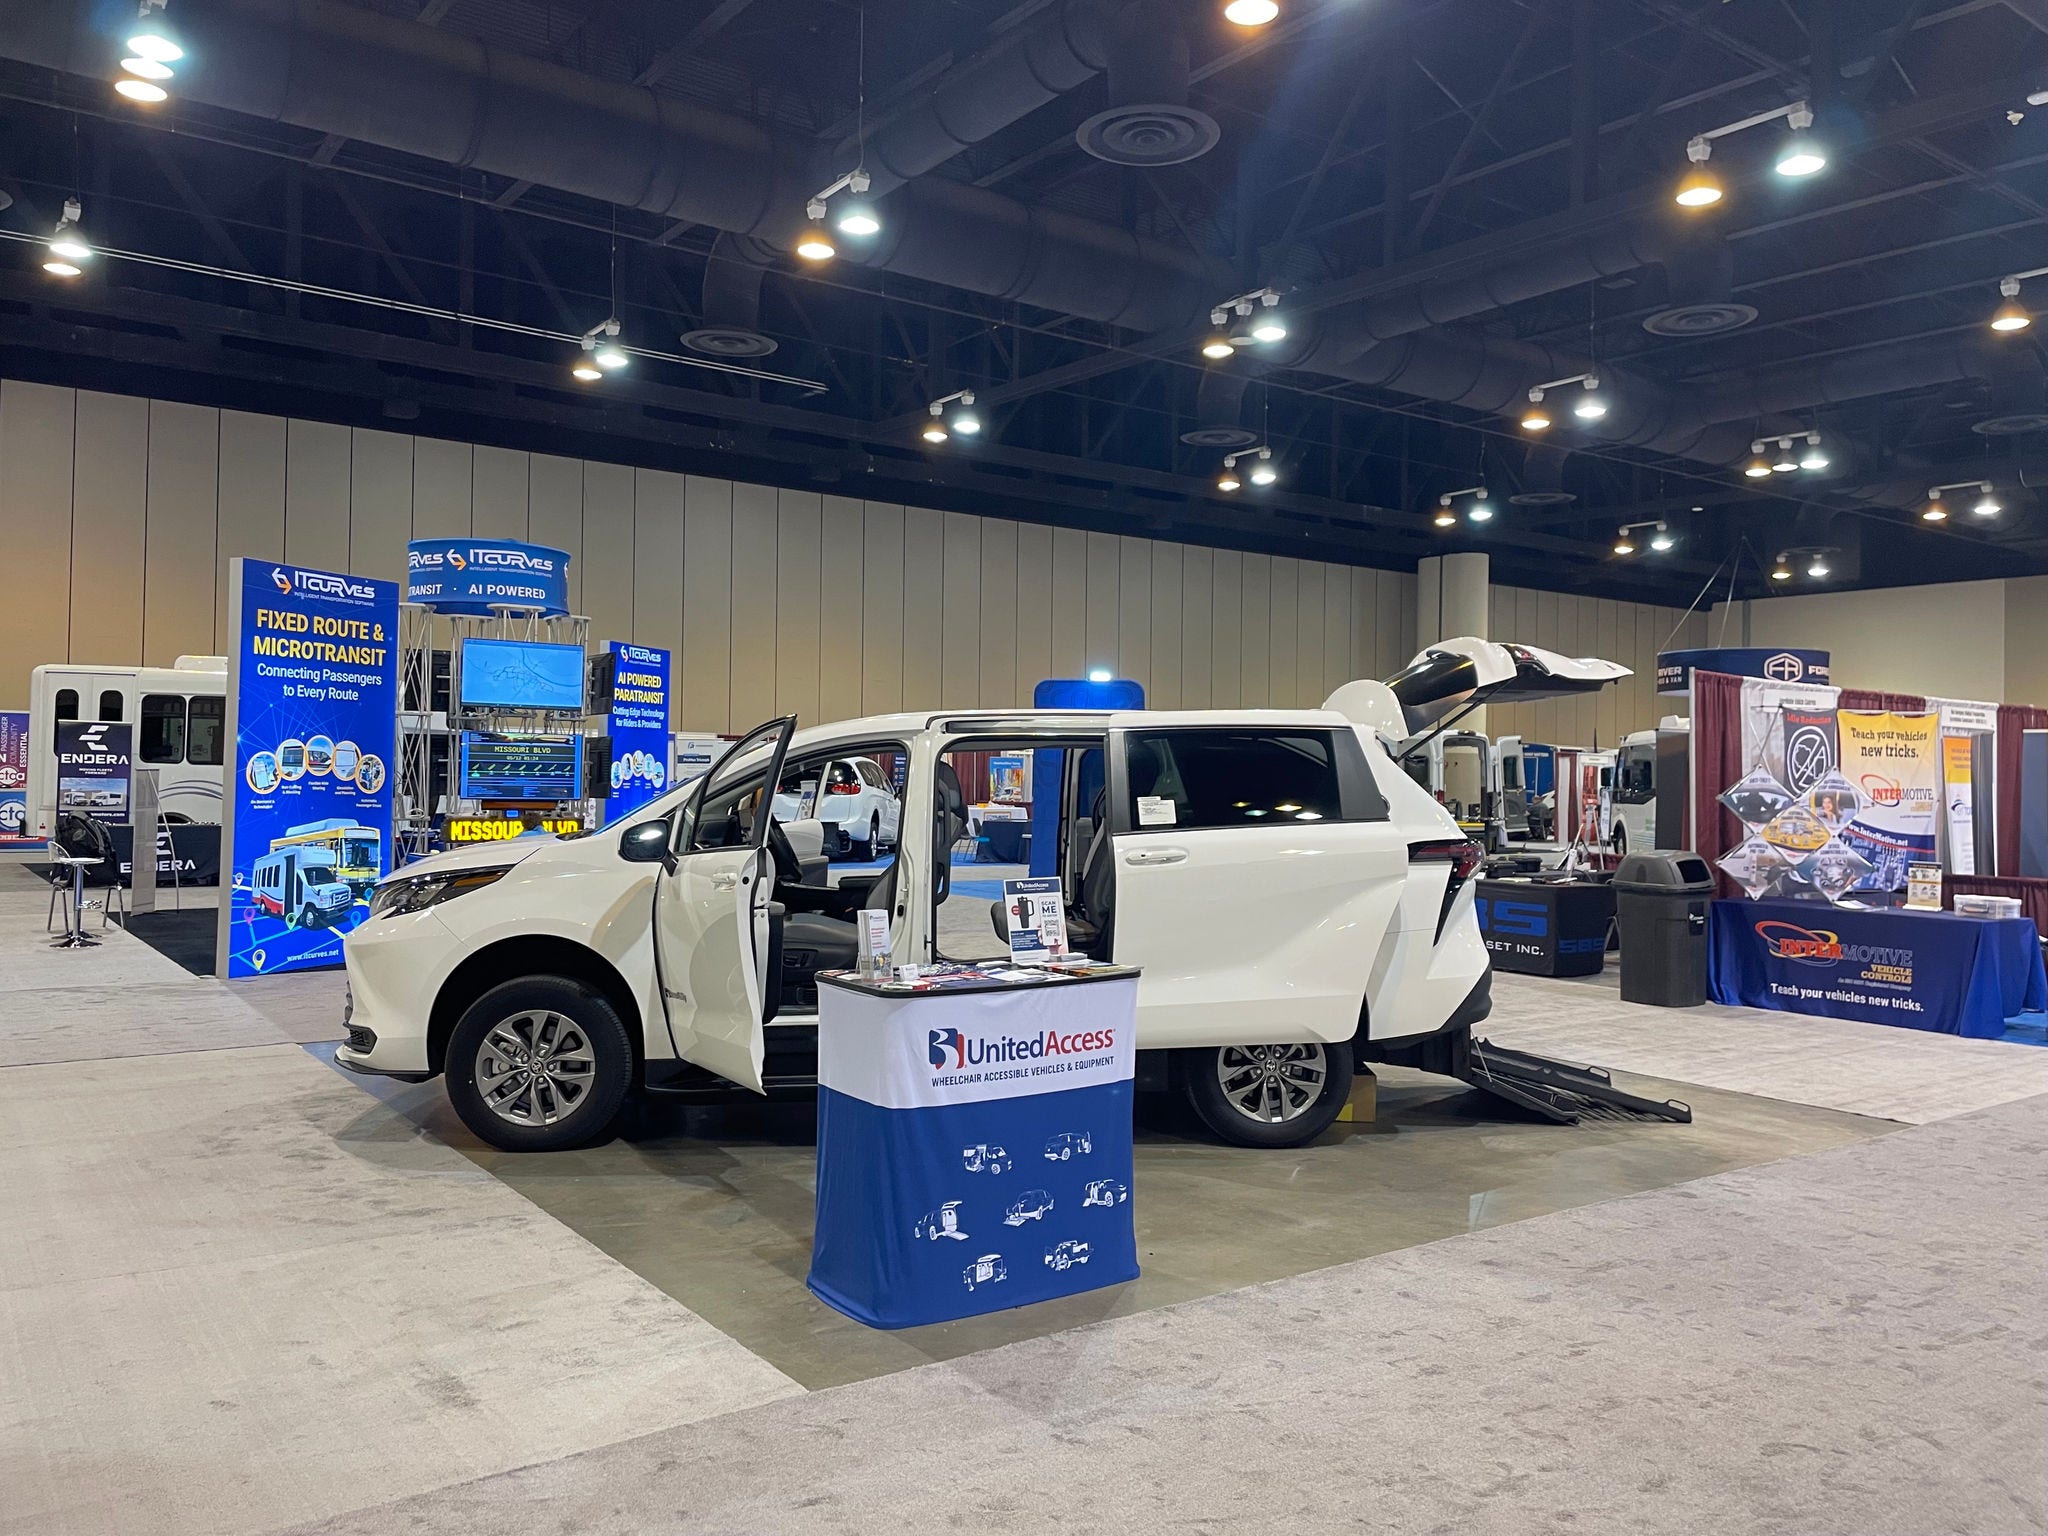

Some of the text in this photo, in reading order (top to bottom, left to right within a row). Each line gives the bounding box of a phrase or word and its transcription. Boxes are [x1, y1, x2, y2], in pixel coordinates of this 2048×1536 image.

[469, 549, 553, 571] ITCURVES
[294, 570, 375, 599] ITCURVES
[469, 584, 546, 599] AI POWERED
[257, 608, 384, 641] FIXED ROUTE &
[253, 636, 386, 666] MICROTRANSIT
[629, 646, 661, 662] ITCURVES
[257, 663, 382, 686] Connecting Passengers
[617, 672, 662, 688] AI POWERED
[283, 684, 359, 701] to Every Route
[614, 688, 664, 704] PARATRANSIT
[612, 706, 665, 720] Cutting Edge Technology
[615, 718, 623, 726] for
[623, 719, 638, 727] Riders
[642, 720, 661, 729] Providers
[1850, 727, 1927, 742] Teach your vehicles
[1861, 743, 1919, 758] new tricks.
[61, 753, 129, 765] ENDERA
[1872, 787, 1934, 801] INTERMOTIVE
[1041, 905, 1057, 914] ME
[1516, 943, 1544, 956] INC.
[1780, 938, 1913, 967] INTERMOTIVE
[1861, 971, 1912, 984] CONTROLS
[1870, 964, 1912, 976] VEHICLE
[1770, 983, 1924, 1012] Teach your vehicles new tricks.
[967, 1028, 1114, 1065] UnitedAccess
[931, 1074, 982, 1087] WHEELCHAIR
[984, 1069, 1029, 1082] ACCESSIBLE
[1031, 1063, 1065, 1076] VEHICLES
[1075, 1056, 1115, 1070] EQUIPMENT
